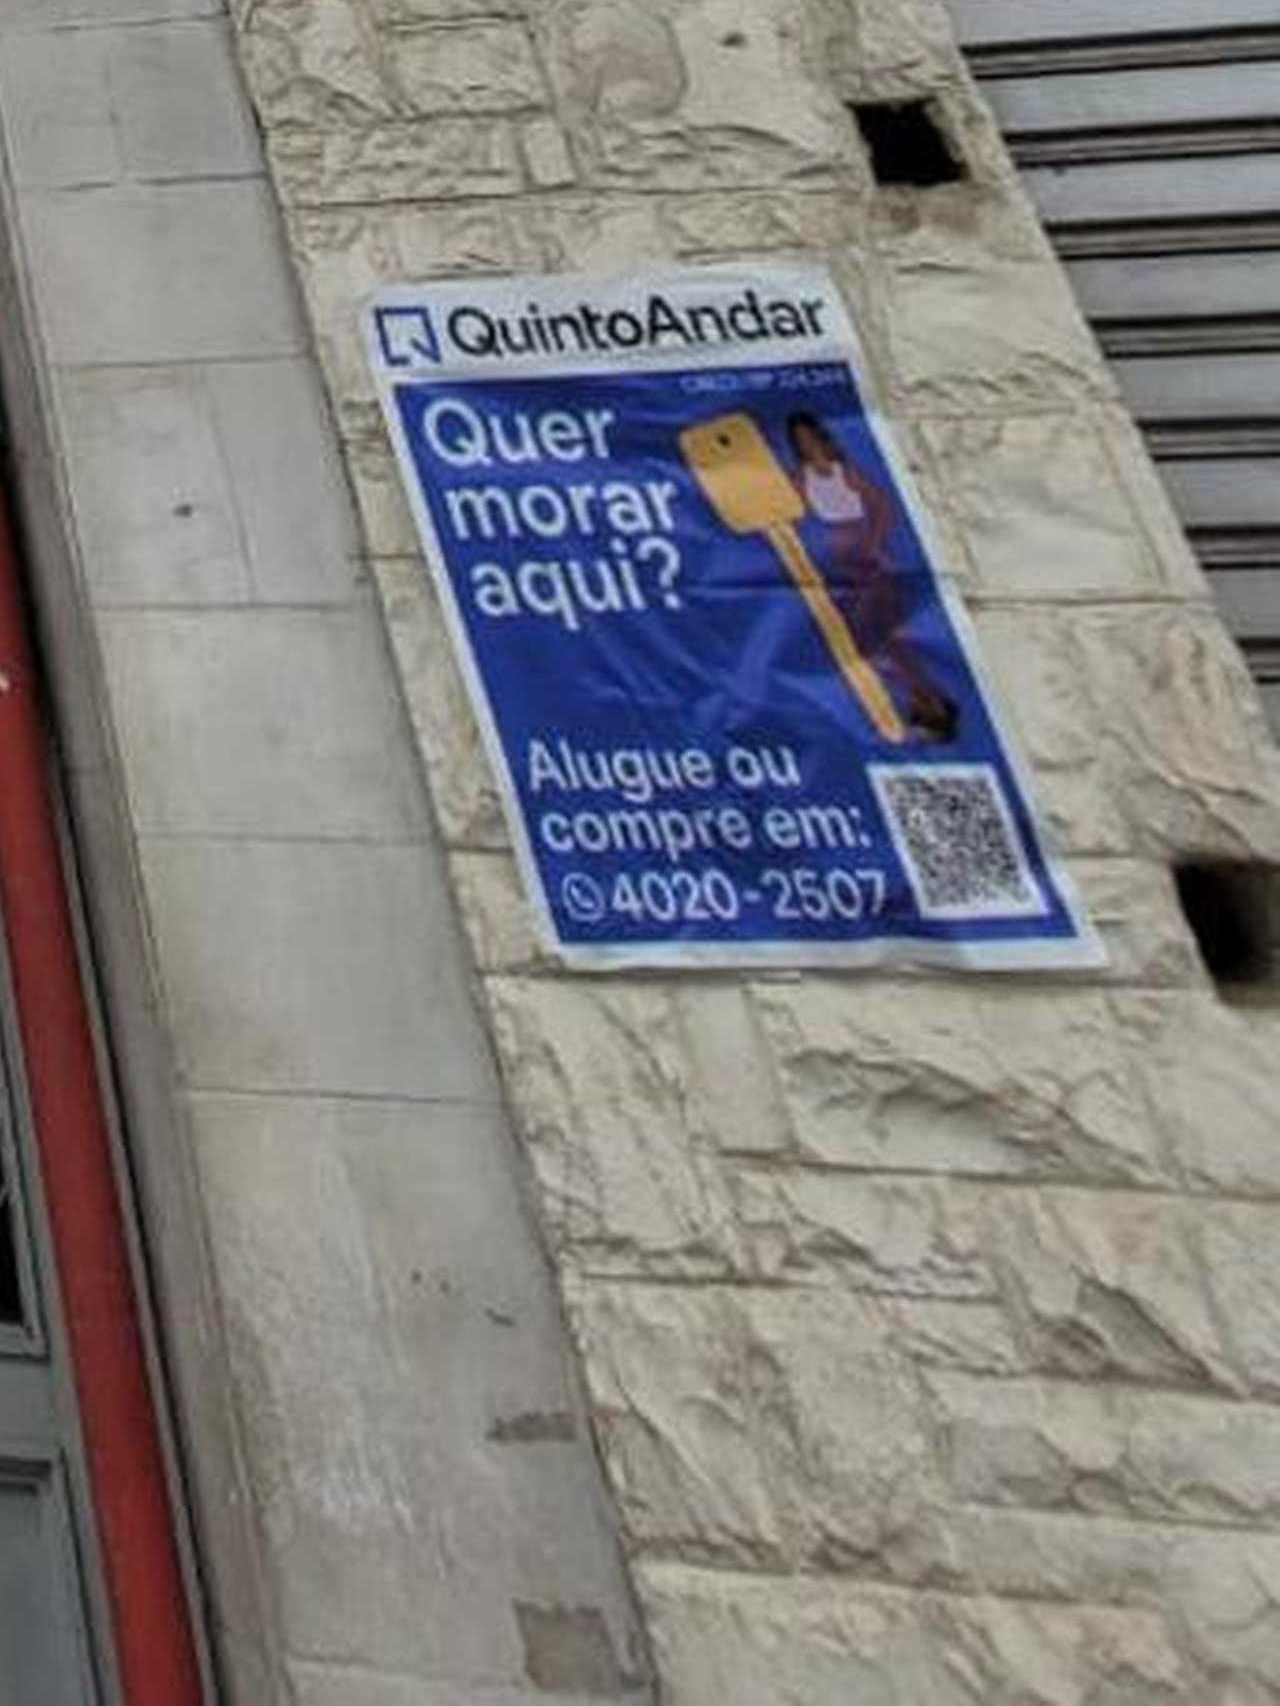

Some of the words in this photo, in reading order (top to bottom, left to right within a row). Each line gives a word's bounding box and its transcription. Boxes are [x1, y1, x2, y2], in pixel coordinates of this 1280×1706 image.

[447, 290, 826, 357] QuintoAndar
[423, 397, 615, 466] Quer
[445, 479, 677, 539] morar
[471, 536, 683, 632] aqui?
[528, 739, 715, 803] Alugue
[726, 744, 802, 787] ou
[541, 809, 753, 862] compre
[763, 804, 873, 848] em:
[609, 868, 886, 920] 4020-2507
